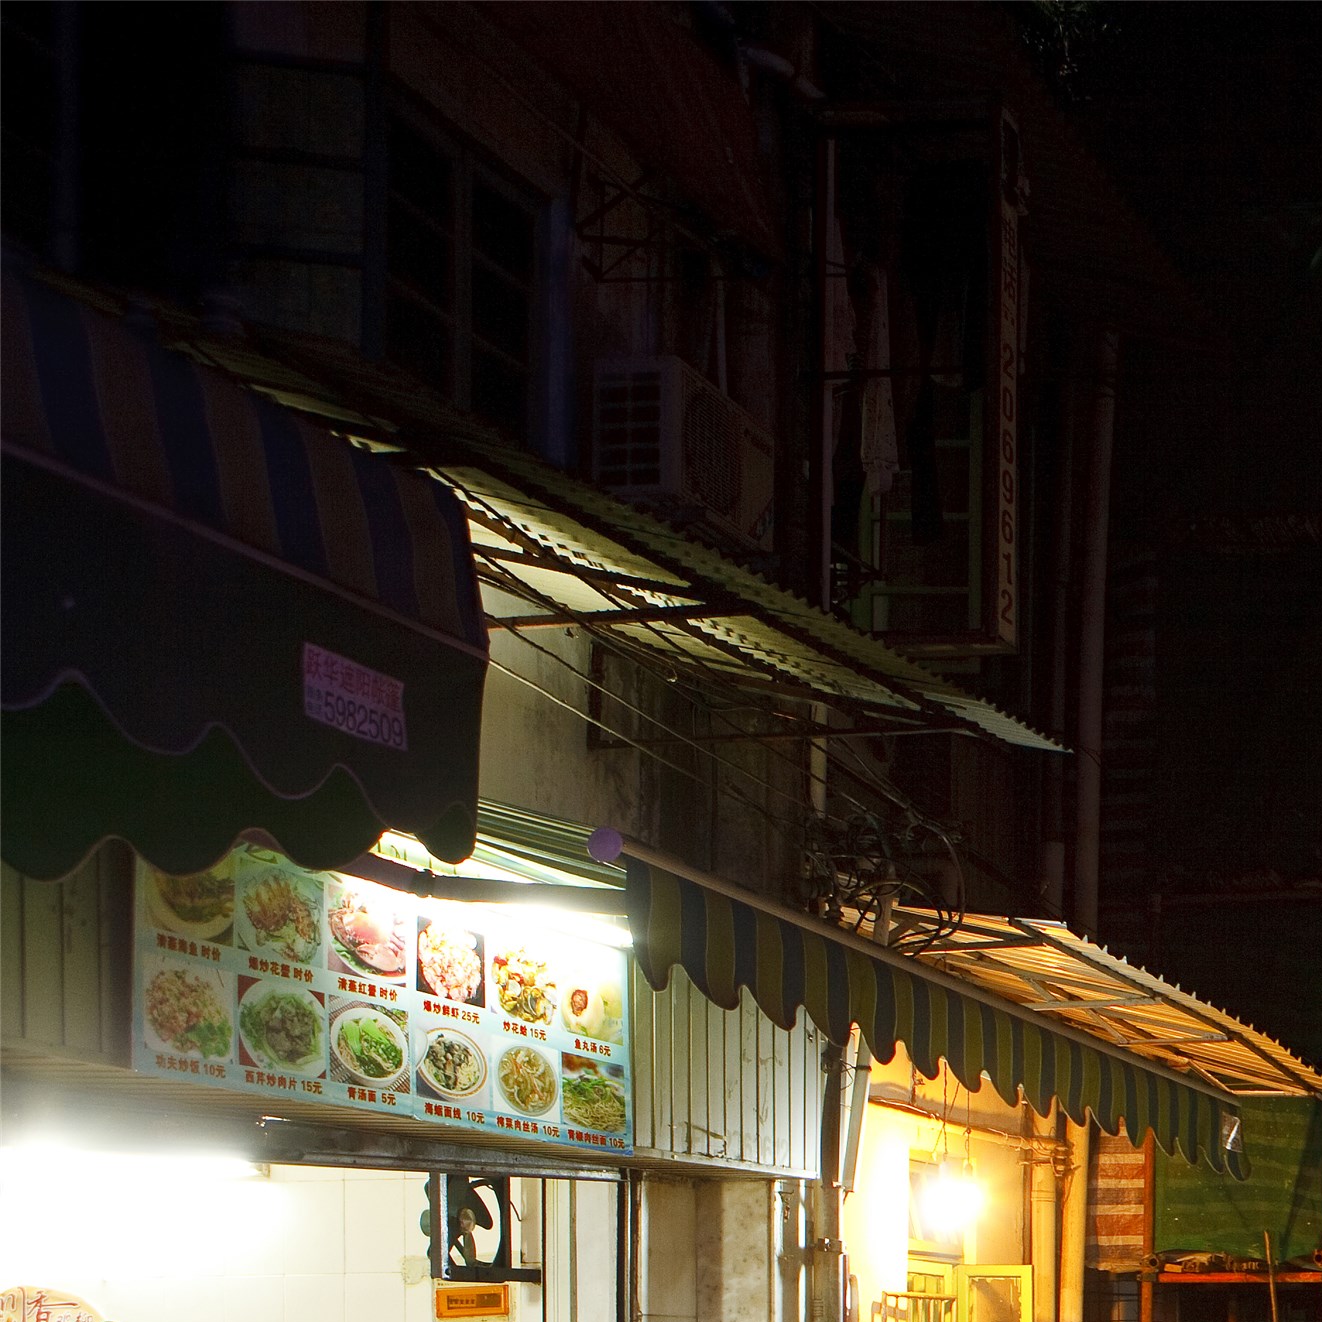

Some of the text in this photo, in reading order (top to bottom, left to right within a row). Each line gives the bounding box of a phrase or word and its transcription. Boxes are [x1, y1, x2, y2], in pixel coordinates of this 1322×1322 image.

[324, 691, 403, 746] 5982509
[201, 944, 221, 962] 时价
[293, 967, 314, 984] 时价
[379, 987, 398, 1002] 时价
[462, 1010, 480, 1025] 25元
[530, 1028, 547, 1042] 15元
[574, 1038, 611, 1057] 鱼丸汤 6元
[203, 1062, 226, 1079] 10元
[300, 1080, 323, 1095] 15元
[381, 1093, 397, 1106] 5元
[466, 1111, 485, 1125] 10元
[543, 1125, 560, 1138] 10元
[609, 1137, 625, 1149] 10元
